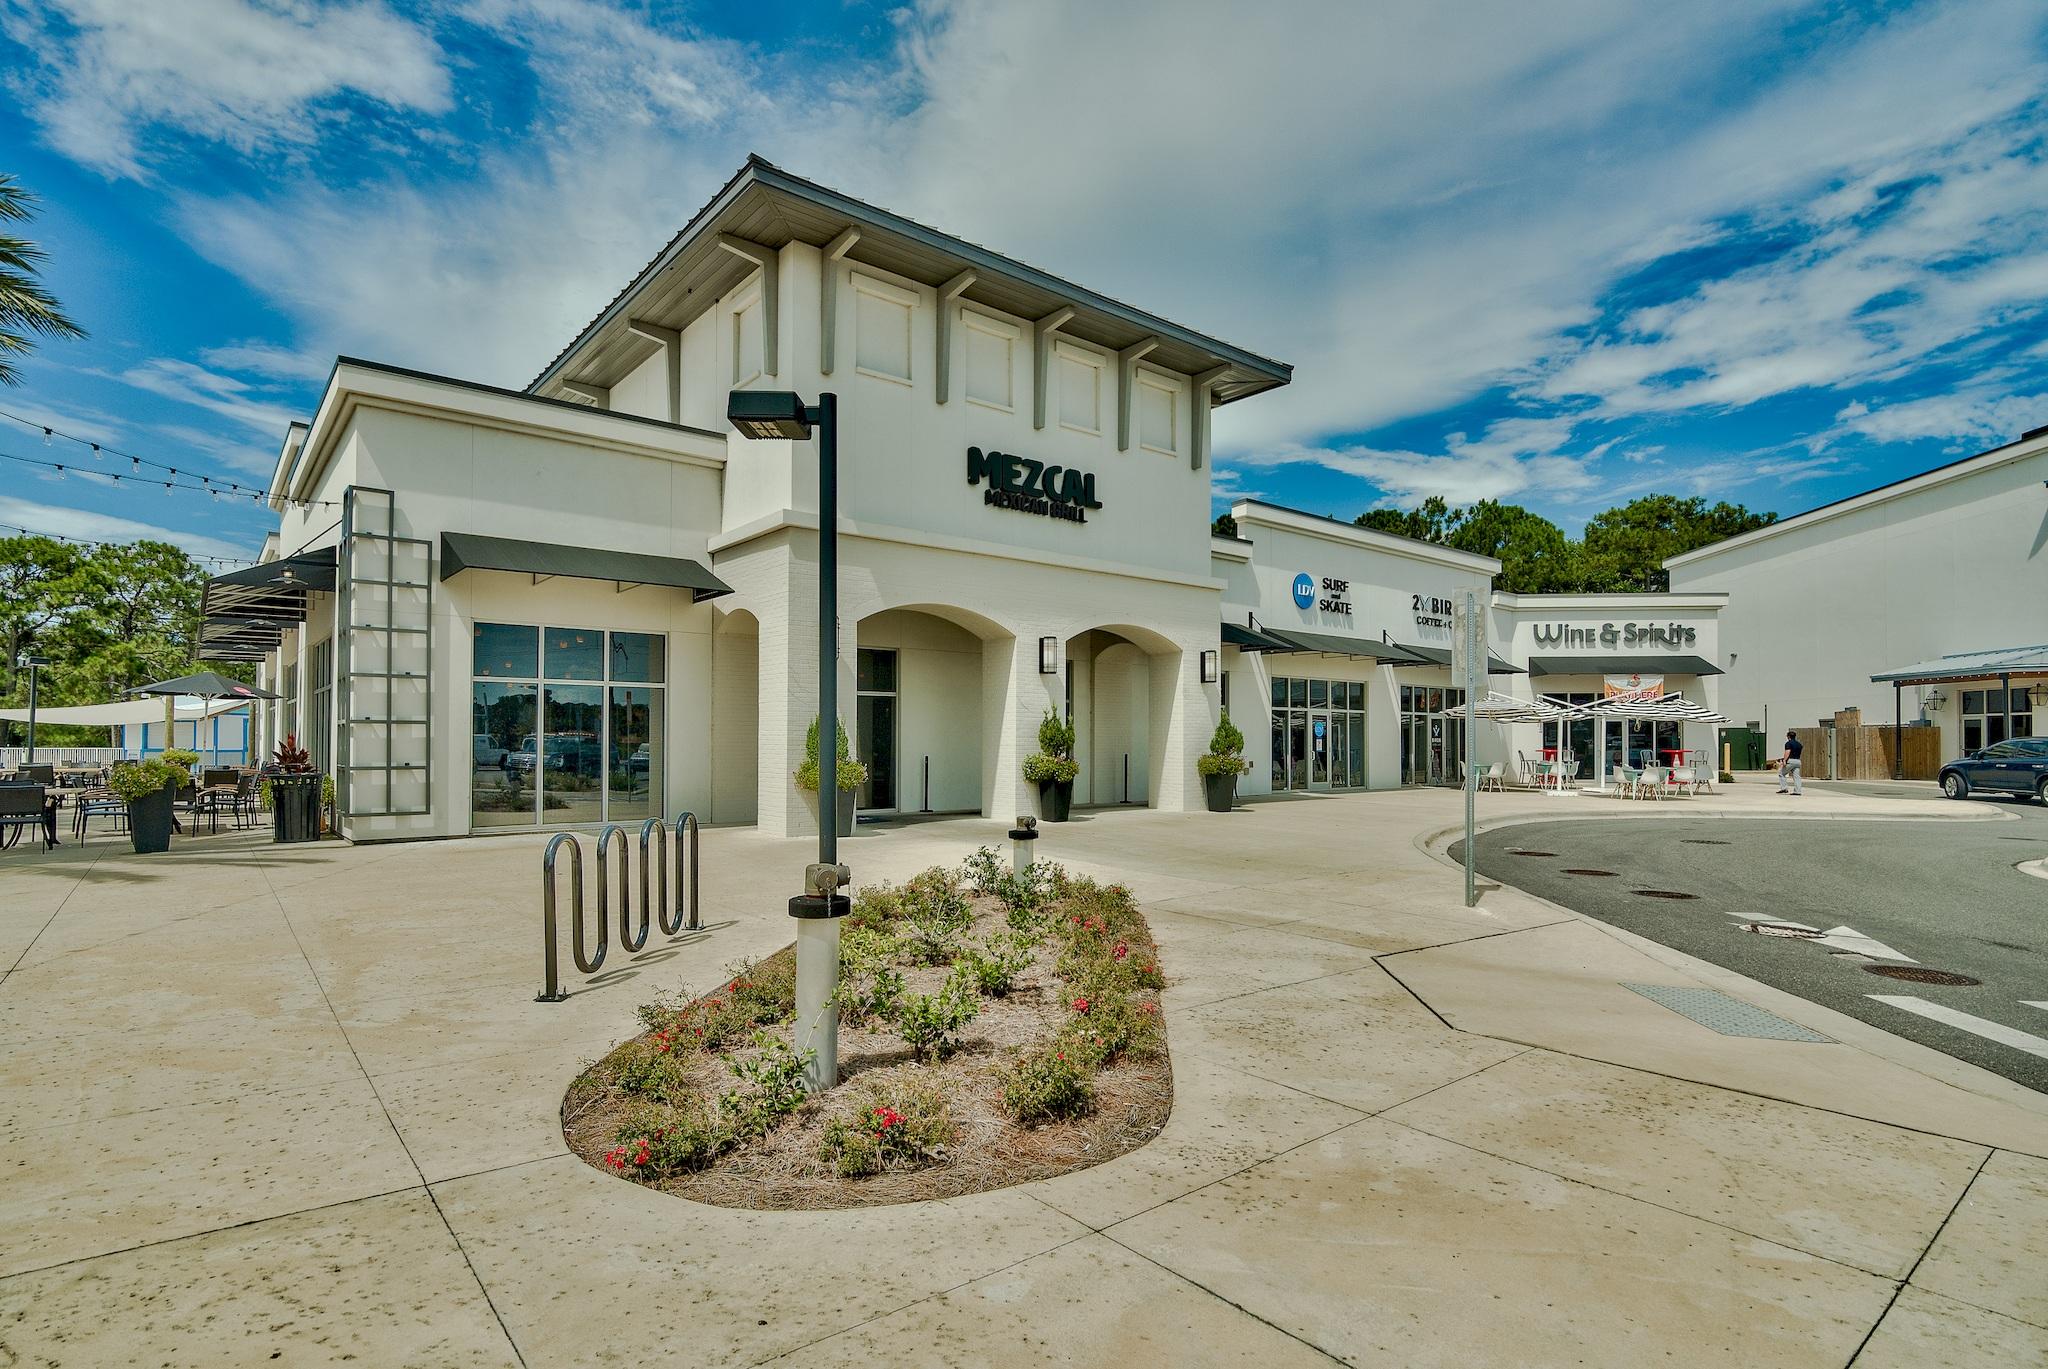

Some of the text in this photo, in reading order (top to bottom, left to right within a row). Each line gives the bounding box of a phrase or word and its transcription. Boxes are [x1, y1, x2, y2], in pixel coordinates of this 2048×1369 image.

[967, 446, 1102, 509] MEZCAL
[984, 489, 1088, 523] MEXICAN GRILL
[1322, 577, 1349, 592] SURF
[1319, 599, 1352, 615] SKATE
[1412, 594, 1453, 616] 2 BIR
[1416, 616, 1443, 628] COFFEE
[1599, 622, 1621, 644] &
